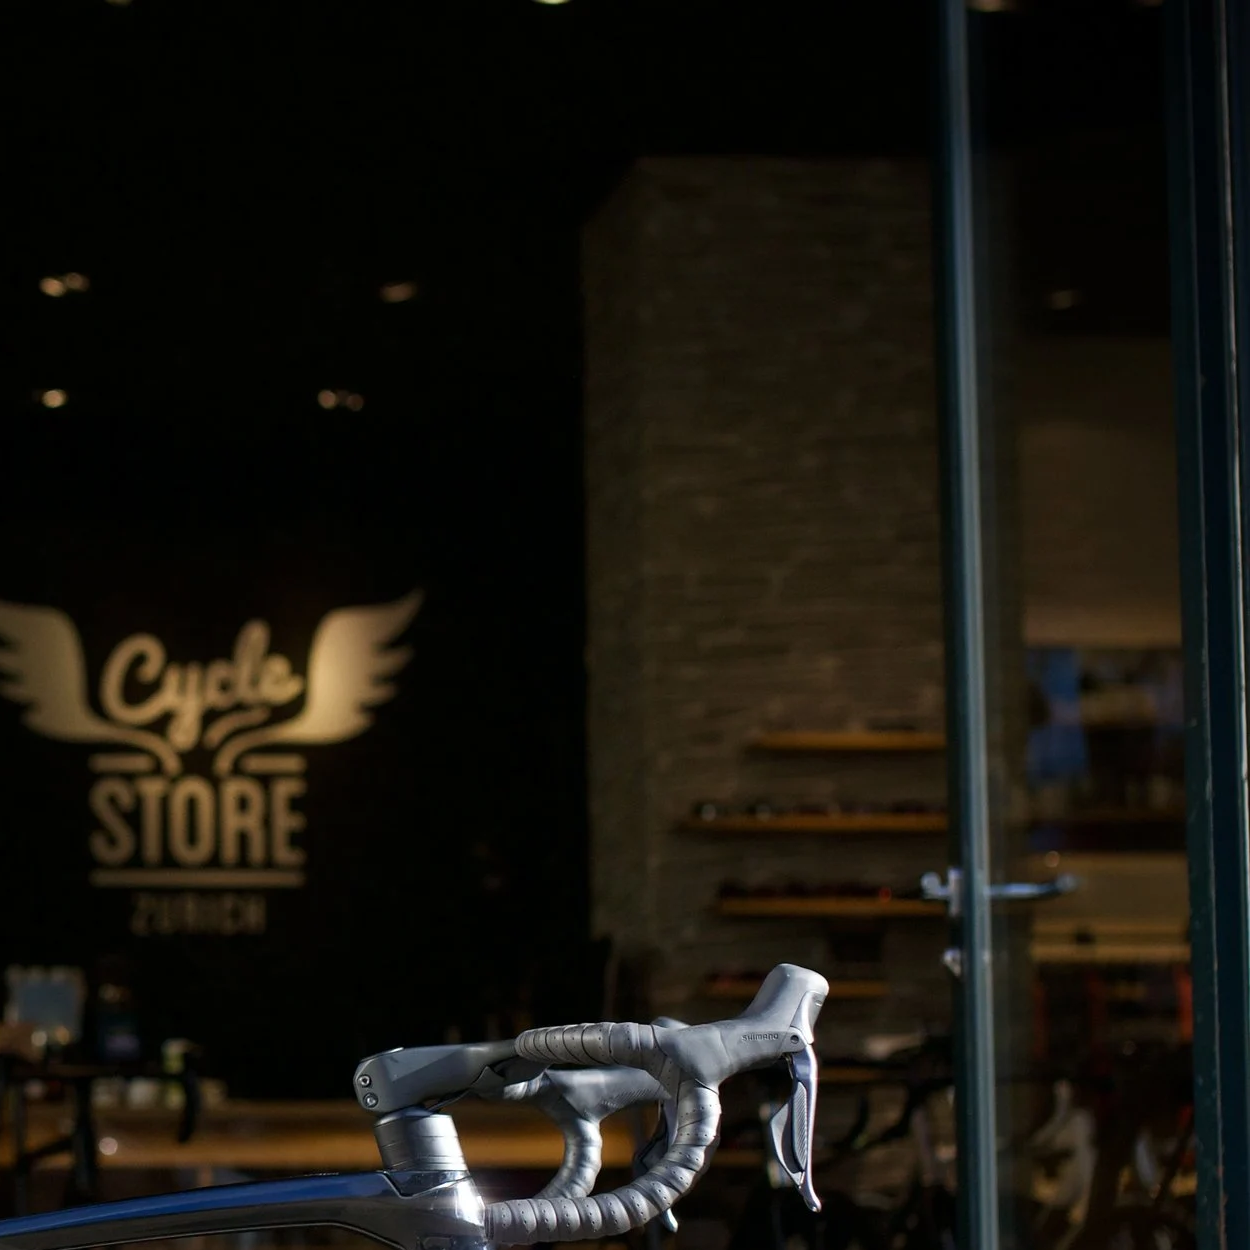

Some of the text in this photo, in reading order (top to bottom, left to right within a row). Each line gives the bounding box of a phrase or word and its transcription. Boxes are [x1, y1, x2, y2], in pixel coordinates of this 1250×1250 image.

[100, 619, 305, 752] Cycle
[88, 774, 308, 867] STORE
[740, 1032, 779, 1042] SHIMANO
